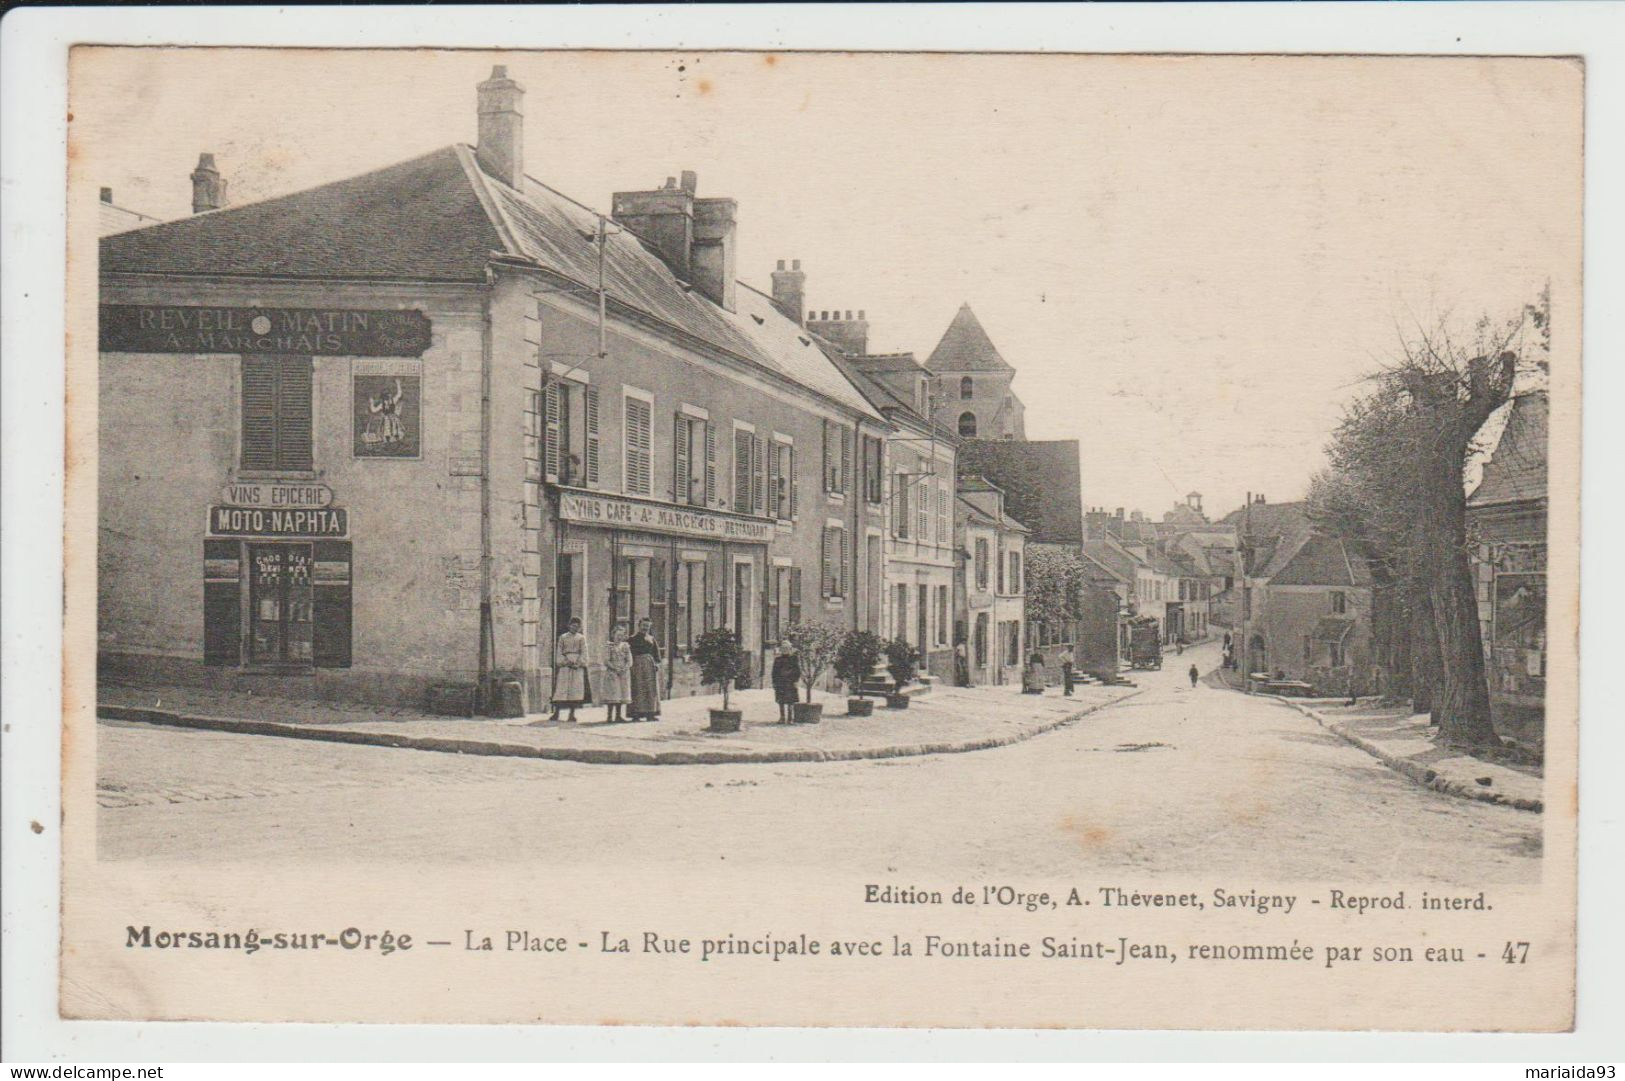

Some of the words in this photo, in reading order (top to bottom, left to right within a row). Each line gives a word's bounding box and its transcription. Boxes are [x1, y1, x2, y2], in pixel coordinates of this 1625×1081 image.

[140, 308, 242, 330] REVEIL
[281, 311, 369, 333] MATIN
[198, 333, 342, 351] MARCHAIS
[229, 486, 260, 503] VINS
[271, 487, 325, 505] EPICERIE
[865, 885, 942, 905] Edition
[951, 886, 975, 905] de
[983, 886, 1057, 913] l'Orge,
[1066, 888, 1091, 906] A.
[1098, 887, 1204, 911] Thévenet,
[1213, 888, 1297, 915] Savigny
[1330, 889, 1411, 915] Reprod.
[1421, 891, 1493, 911] interd.
[126, 926, 412, 957] Morsang-sur-Orge
[465, 930, 493, 951] La
[506, 931, 567, 952] Place
[601, 931, 630, 953] La
[643, 932, 691, 954] Rue
[702, 933, 820, 962] principale
[831, 941, 883, 957] avec
[893, 935, 912, 957] la
[924, 935, 1030, 958] Fontaine
[1041, 936, 1176, 966] Saint-Jean,
[1188, 939, 1313, 961] renommée
[1325, 946, 1363, 968] par
[1373, 946, 1413, 962] son
[1424, 947, 1465, 962] eau
[1501, 941, 1531, 965] 47
